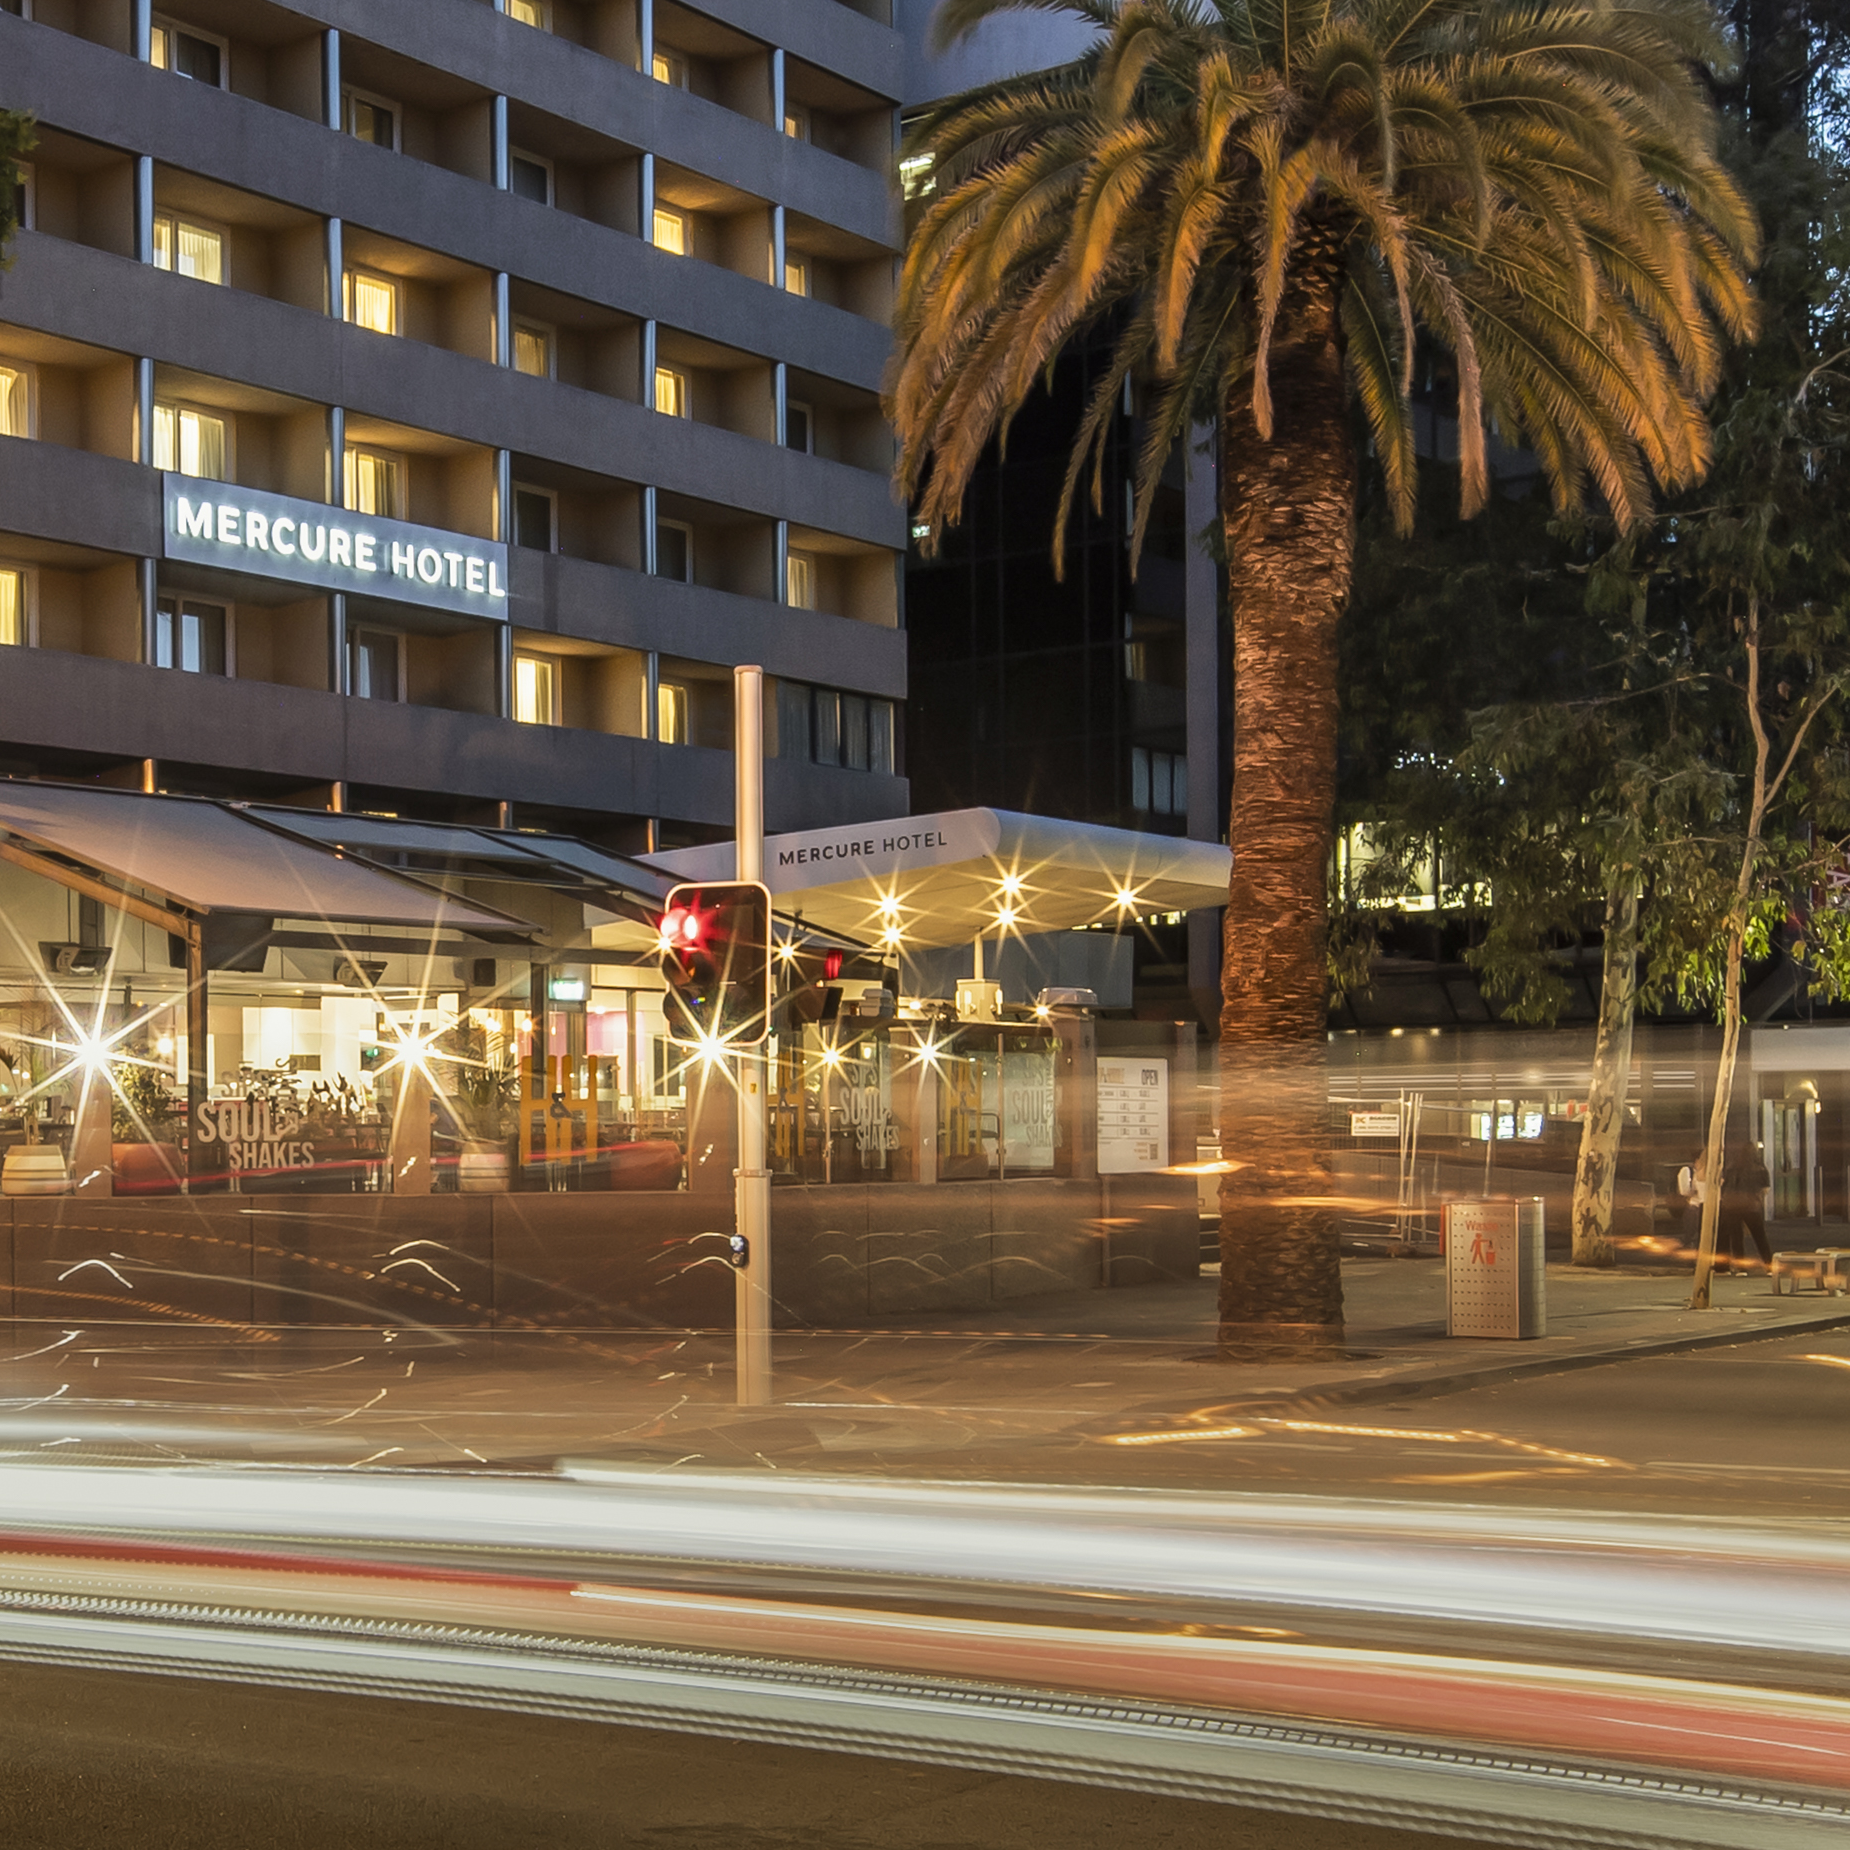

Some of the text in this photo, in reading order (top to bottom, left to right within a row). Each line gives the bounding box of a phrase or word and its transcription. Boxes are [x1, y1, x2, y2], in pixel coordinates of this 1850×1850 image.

[177, 496, 506, 597] MERCURE HOTEL
[779, 832, 948, 865] MERCURE HOTEL
[197, 1101, 281, 1143] SOUL
[840, 1087, 885, 1125] SOUL
[1013, 1090, 1048, 1125] SOUL
[229, 1141, 315, 1169] SHAKES
[856, 1125, 899, 1150] SHAKES
